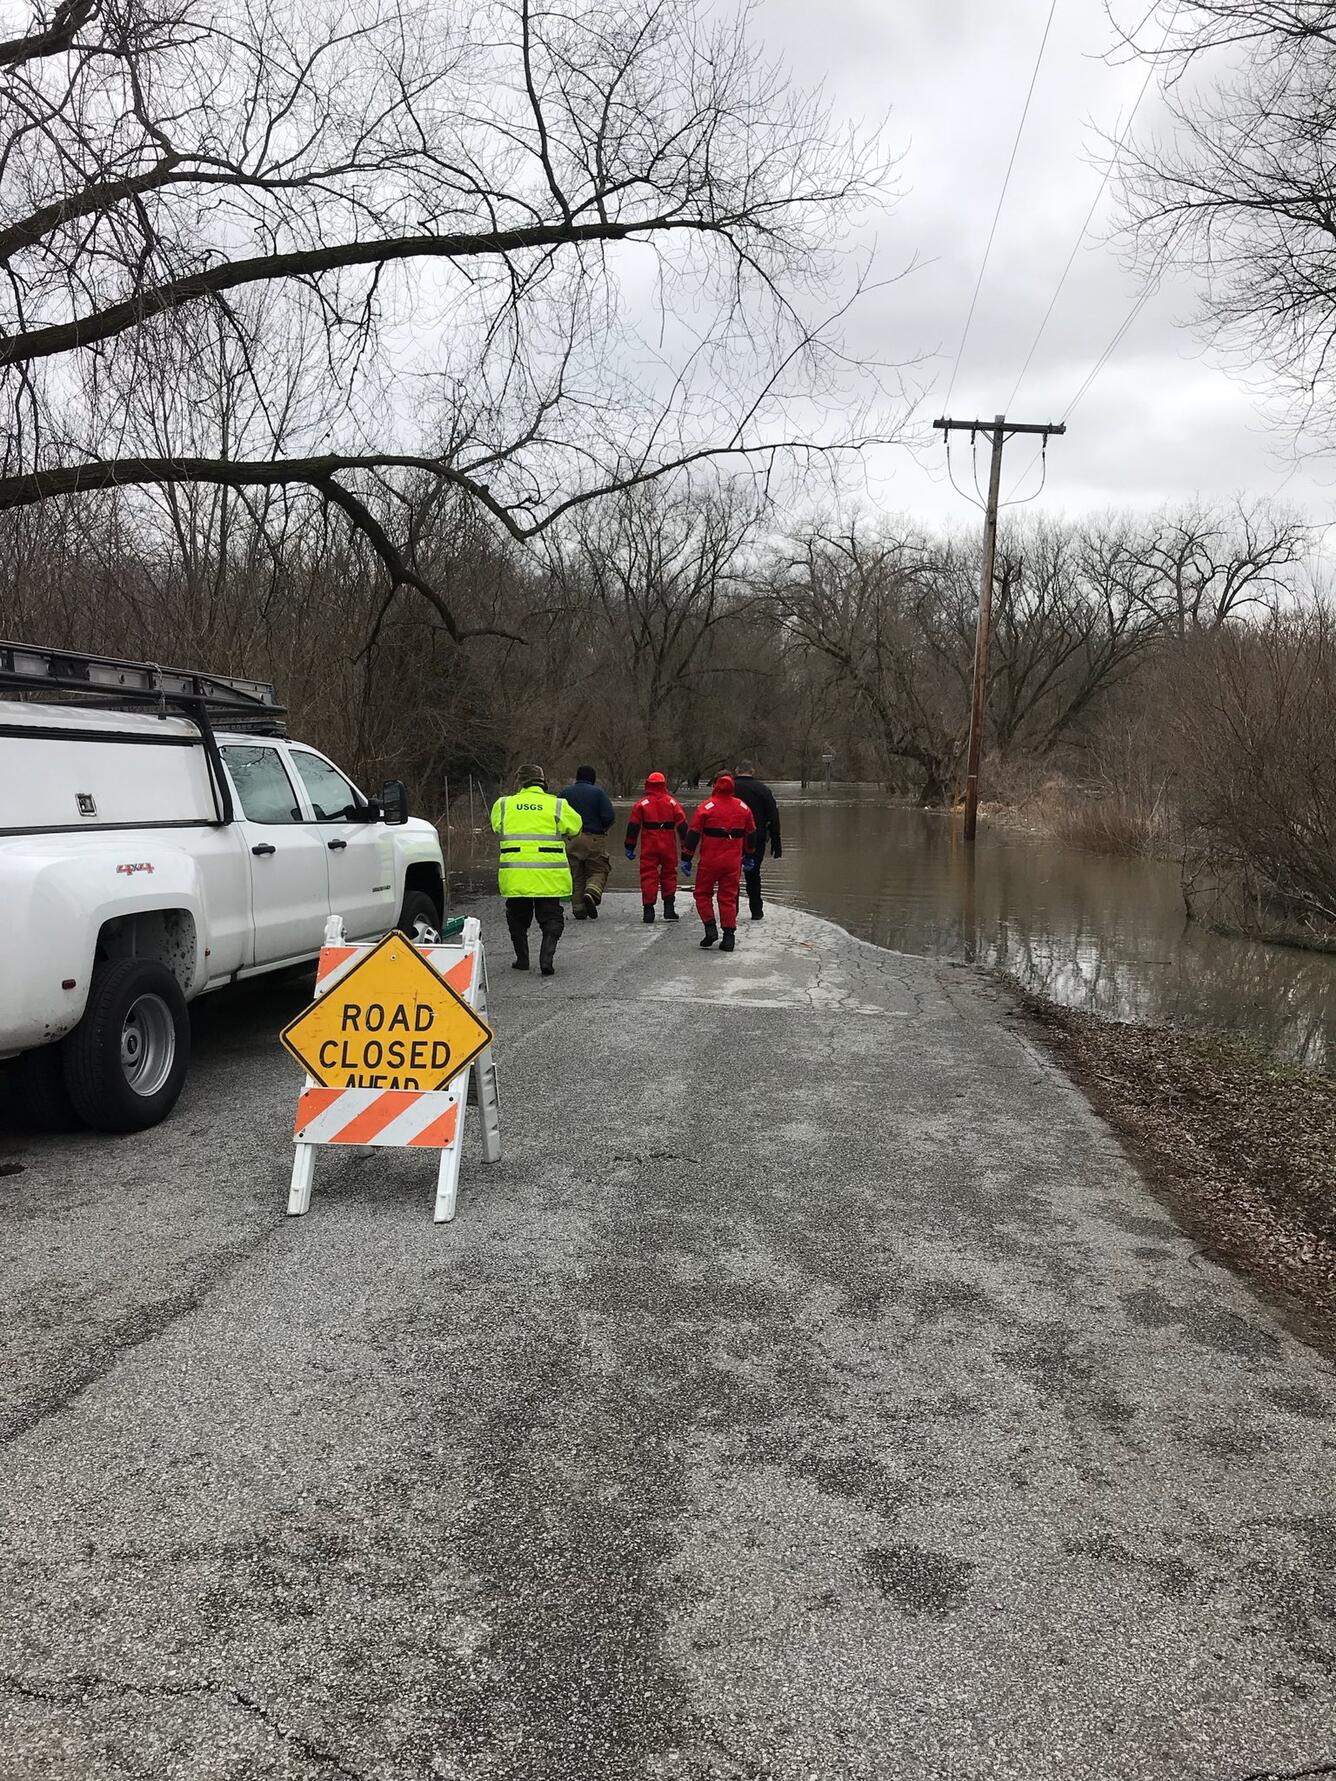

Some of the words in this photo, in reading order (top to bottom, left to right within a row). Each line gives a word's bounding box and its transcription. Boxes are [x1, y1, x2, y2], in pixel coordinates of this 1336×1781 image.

[516, 803, 544, 811] USGS
[341, 1003, 435, 1032] ROAD
[319, 1040, 451, 1069] CLOSED
